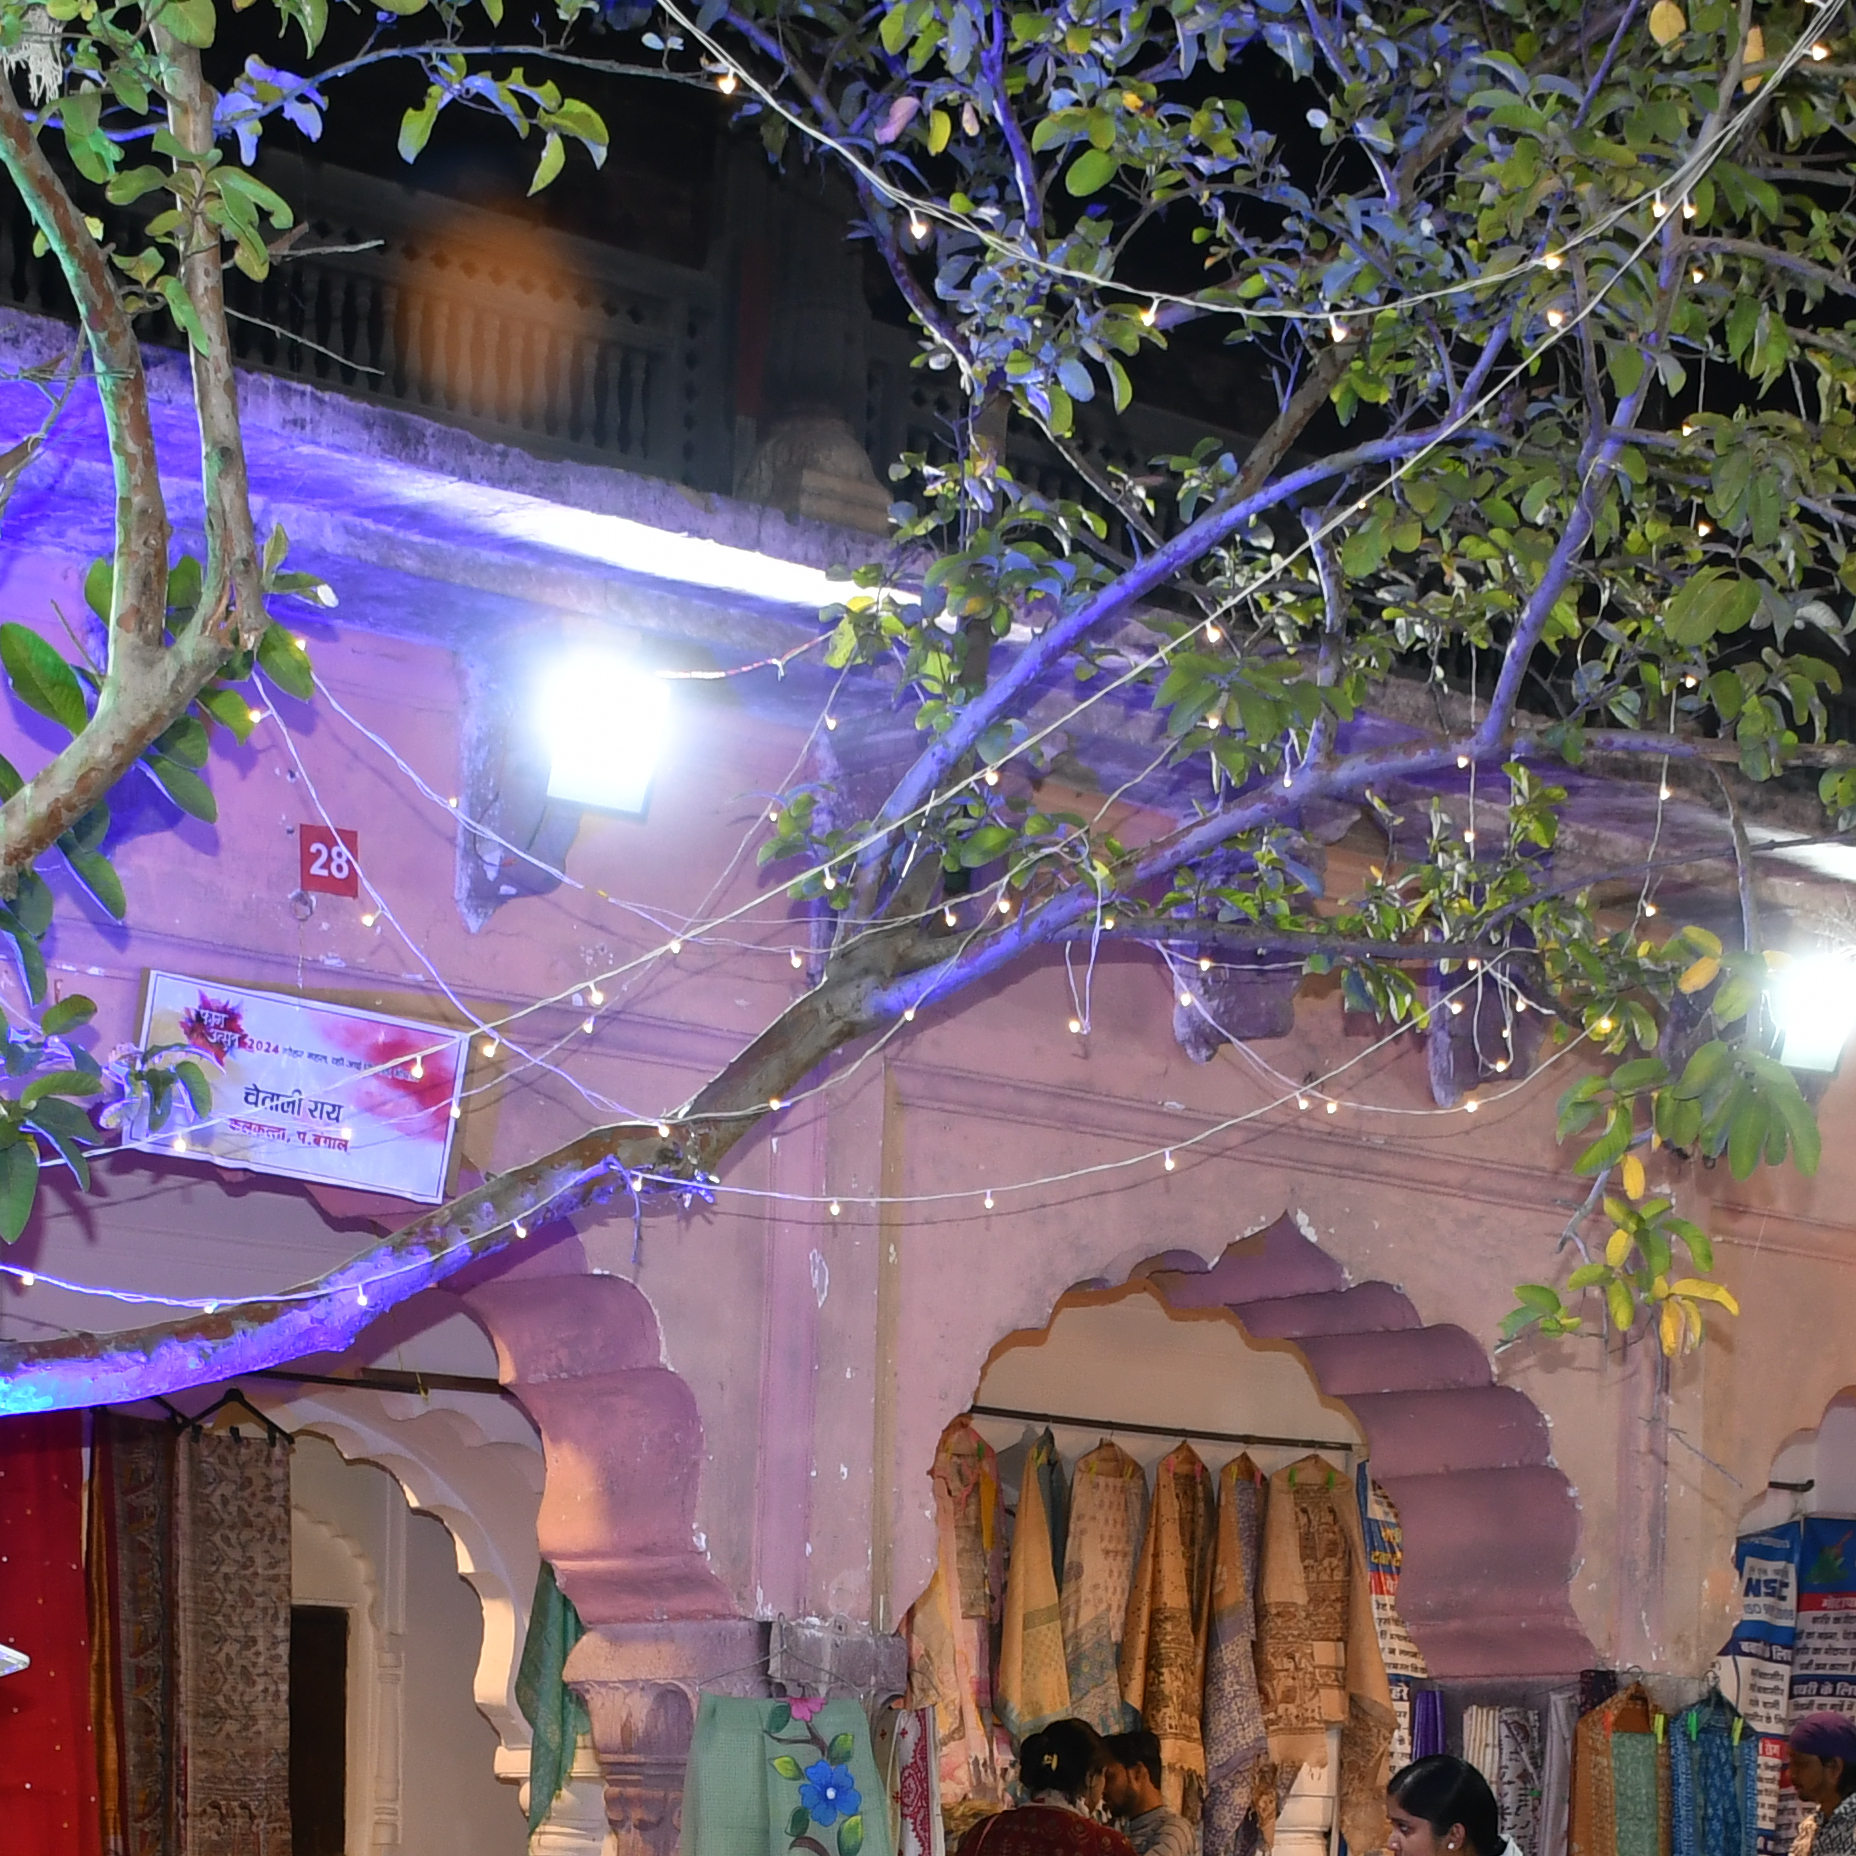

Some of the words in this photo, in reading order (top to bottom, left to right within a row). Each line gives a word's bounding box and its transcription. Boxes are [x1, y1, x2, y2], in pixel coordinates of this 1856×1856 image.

[309, 843, 350, 878] 28
[247, 1038, 280, 1054] 2024
[307, 1099, 344, 1123] राय
